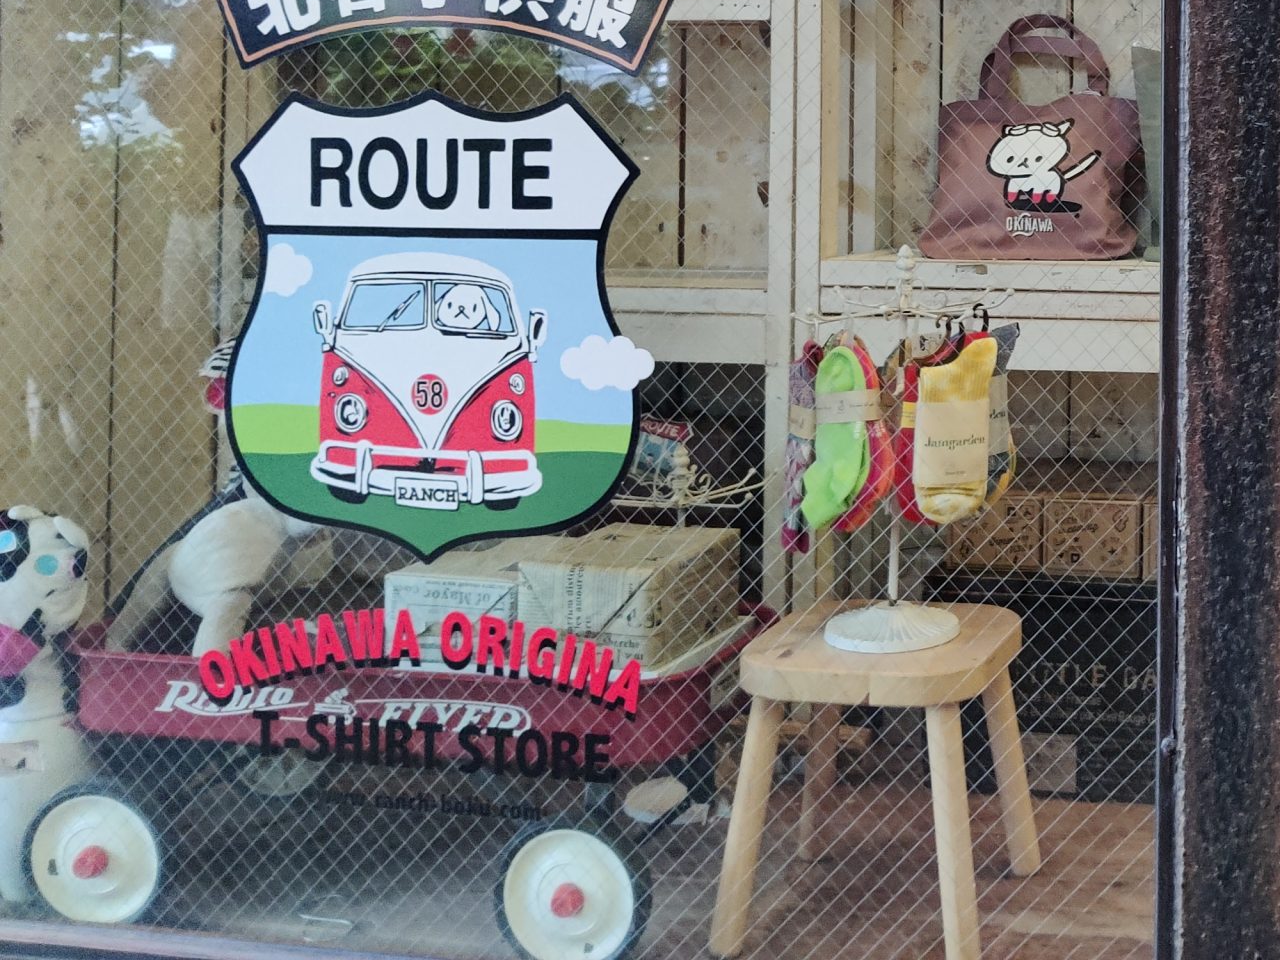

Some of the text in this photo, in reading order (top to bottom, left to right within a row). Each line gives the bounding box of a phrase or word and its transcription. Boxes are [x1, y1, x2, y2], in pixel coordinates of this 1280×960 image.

[310, 136, 553, 211] ROUTE
[1006, 213, 1054, 236] OKINAWA
[416, 381, 443, 409] 58
[398, 486, 457, 503] RANCH
[198, 608, 644, 722] OKINAWA ORIGINA
[254, 710, 616, 784] T-SHIRT STORE
